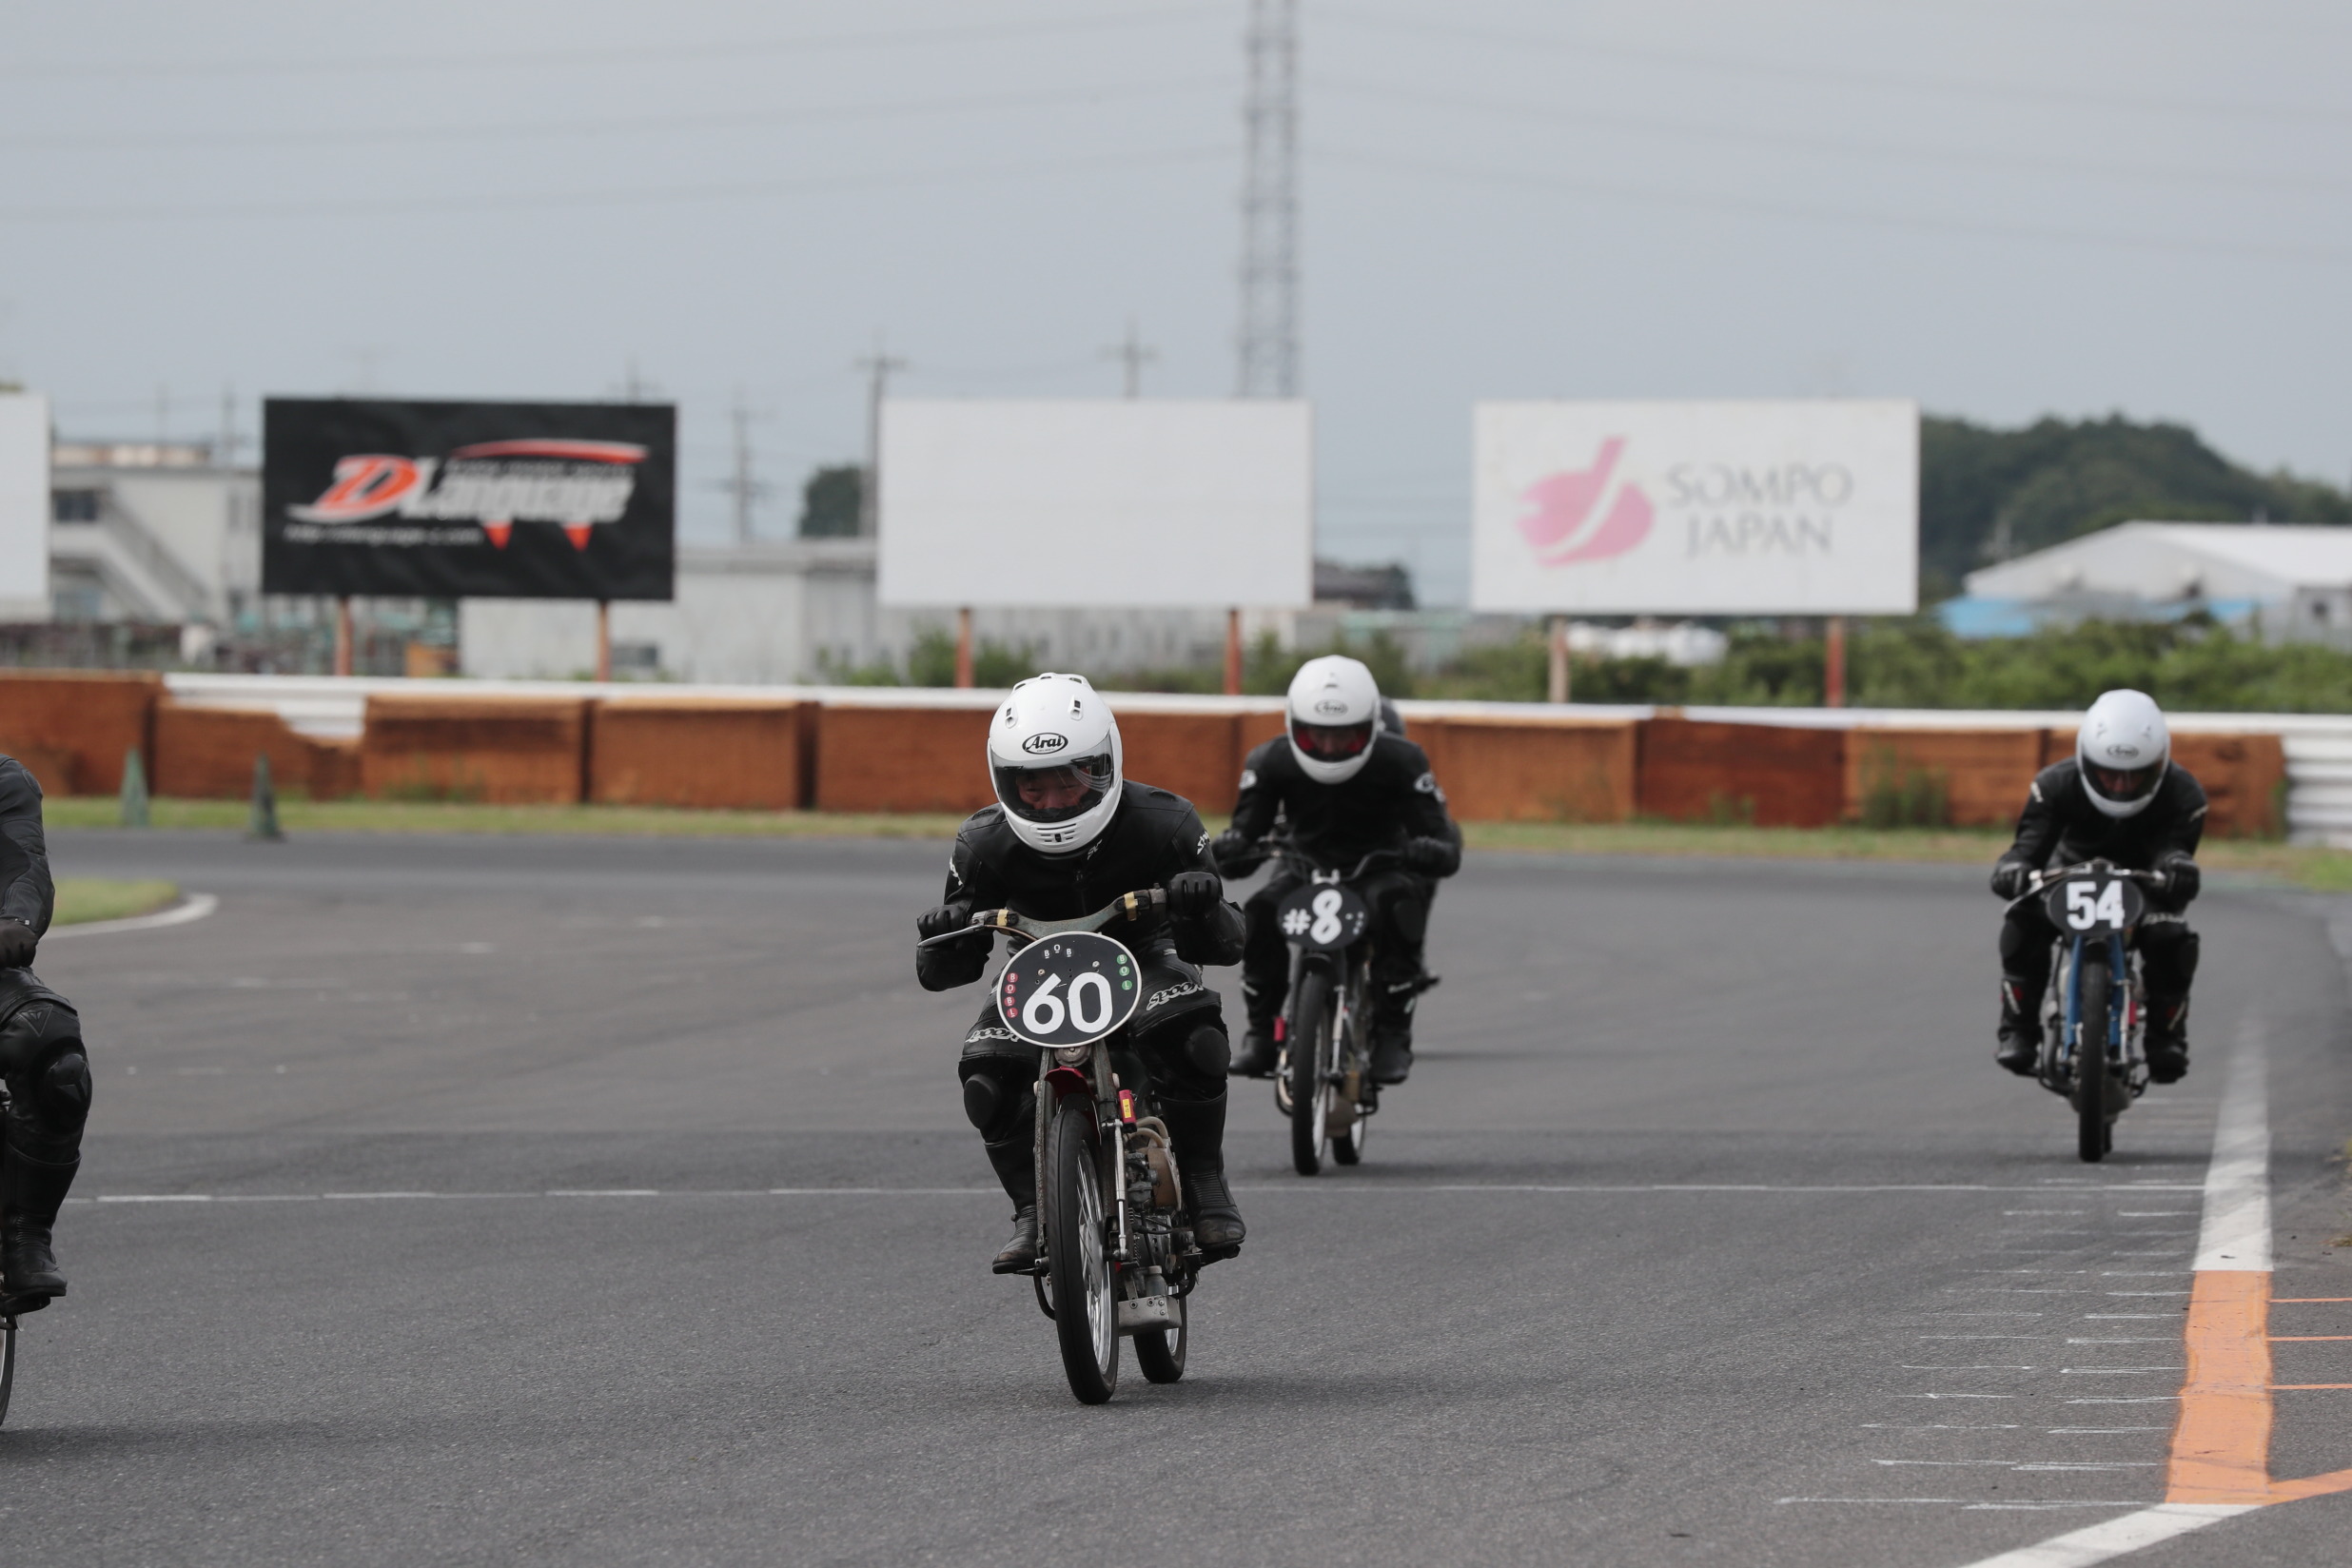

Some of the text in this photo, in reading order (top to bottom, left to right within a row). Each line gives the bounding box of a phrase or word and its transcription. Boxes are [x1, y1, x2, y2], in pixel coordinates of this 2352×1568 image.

[1667, 461, 1854, 510] SOMPO
[1687, 511, 1833, 559] JAPAN
[1027, 735, 1063, 749] Arai
[2066, 879, 2125, 930] 54
[1022, 971, 1113, 1035] 60
